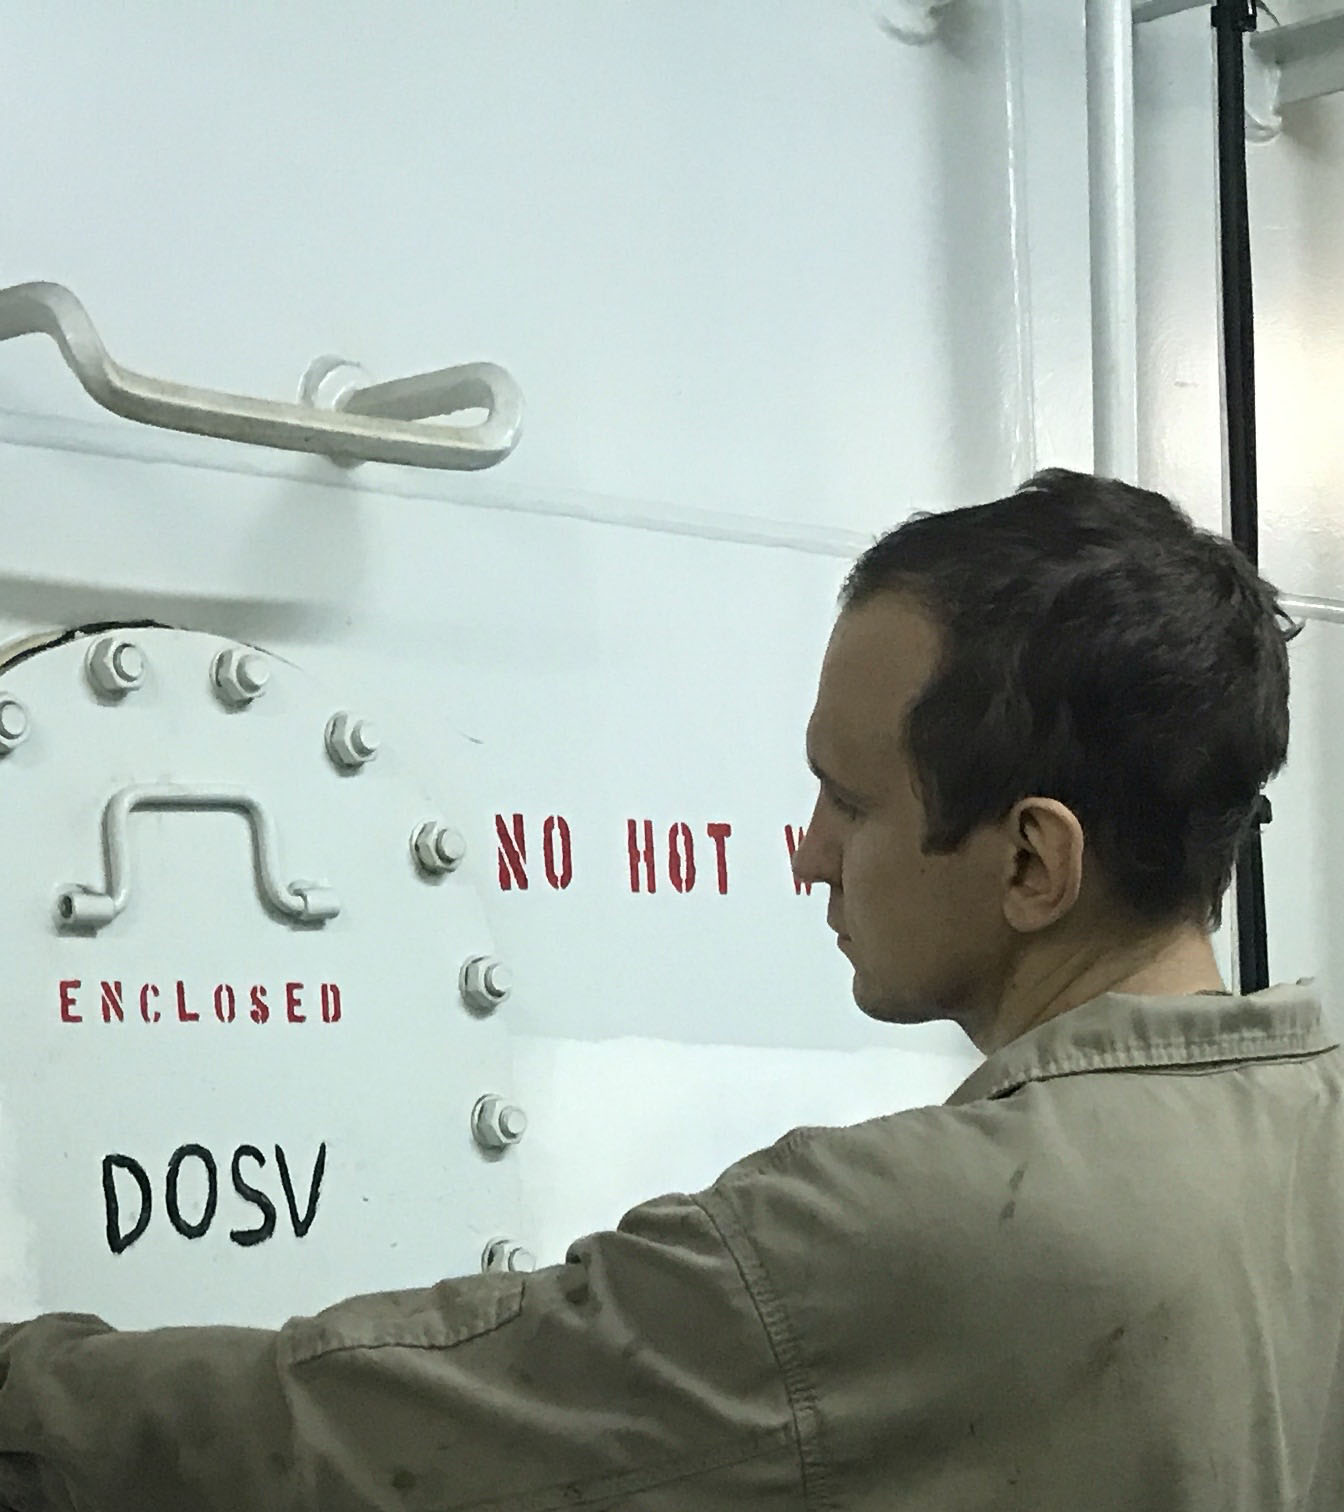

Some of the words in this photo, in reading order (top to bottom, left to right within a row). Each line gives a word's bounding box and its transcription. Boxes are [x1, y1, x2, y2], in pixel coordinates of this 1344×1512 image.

[495, 813, 572, 890] NO
[627, 818, 732, 896] HOT
[59, 979, 343, 1025] ENCLOSED
[101, 1142, 327, 1254] DOSV
